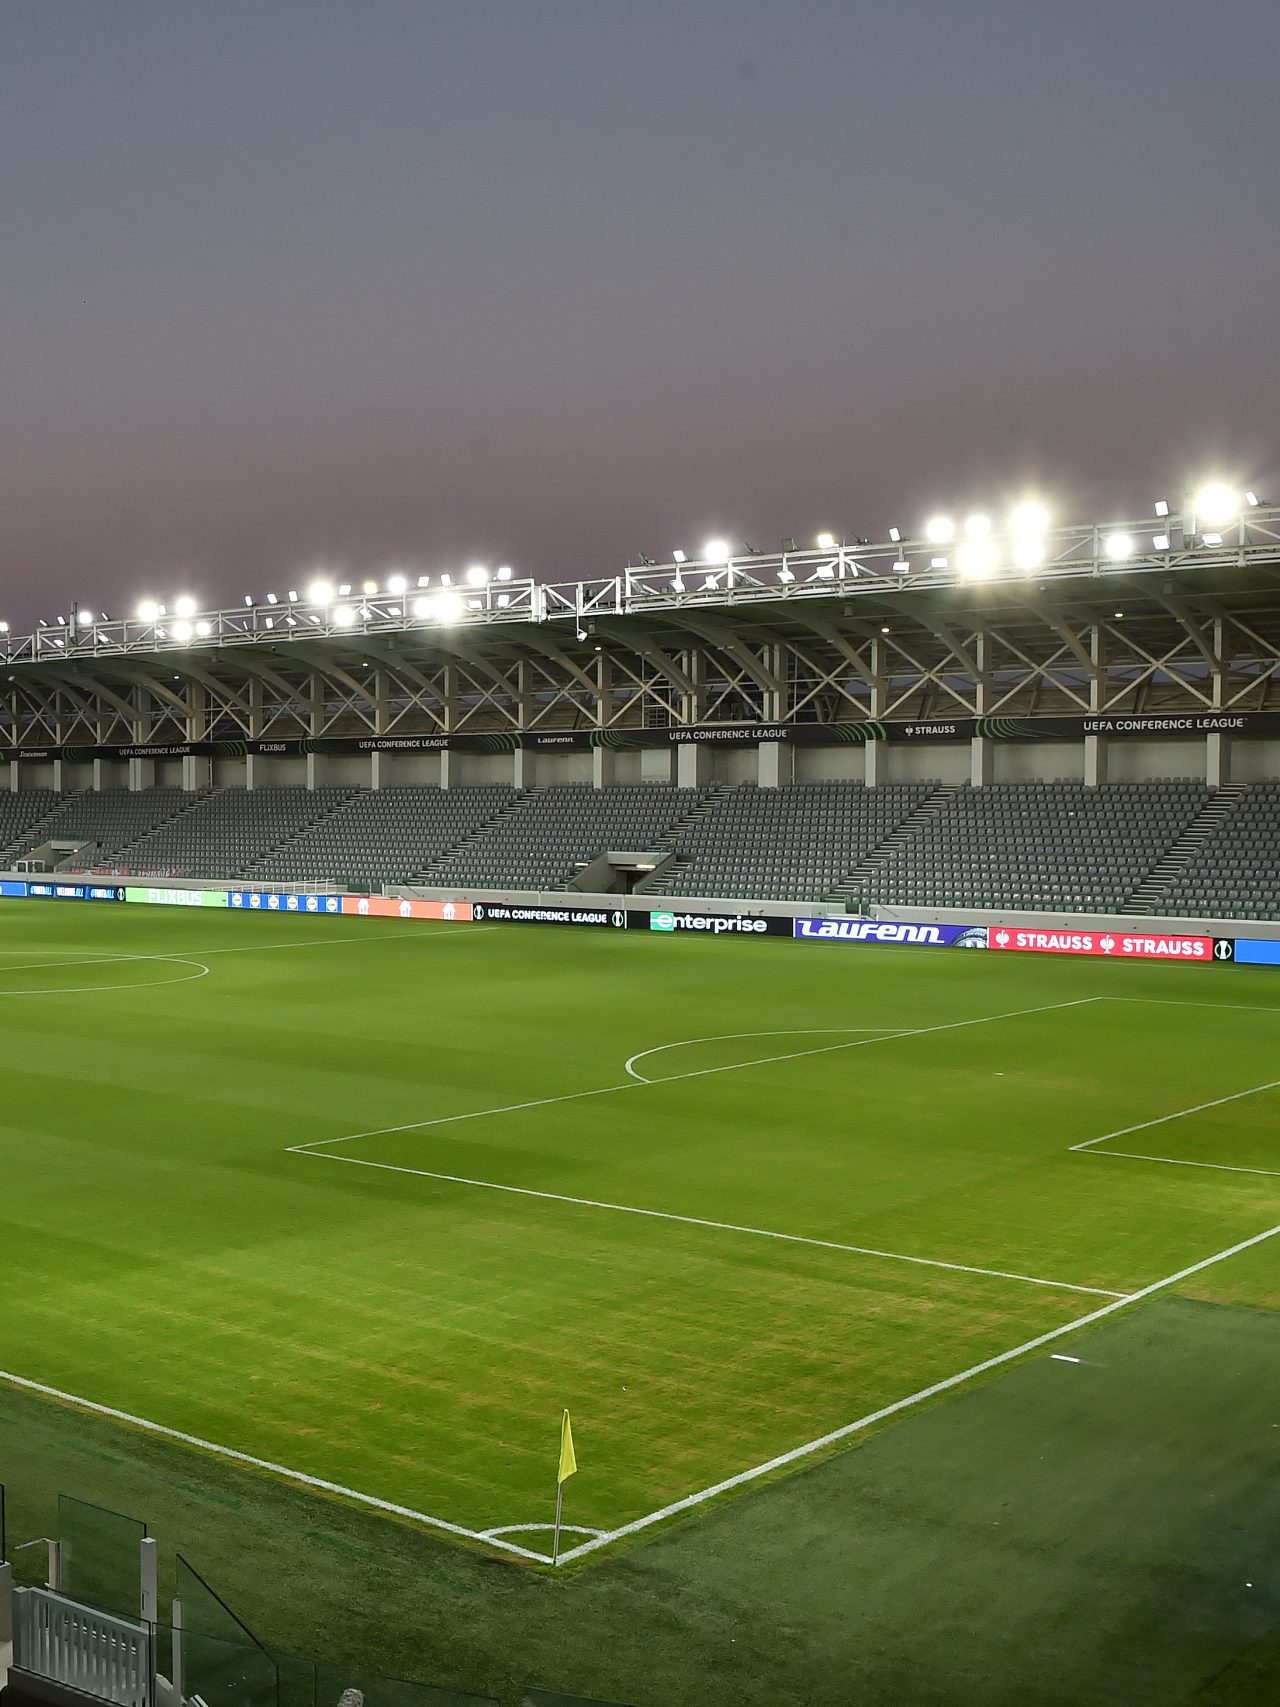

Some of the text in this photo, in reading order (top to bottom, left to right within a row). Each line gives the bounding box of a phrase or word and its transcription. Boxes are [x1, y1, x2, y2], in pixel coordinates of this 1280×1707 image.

[914, 725, 956, 735] STRAUSS
[1083, 718, 1244, 731] UEFA CONFERENCE LEAGUE
[669, 729, 787, 740] UEFA CONFERENCE LEAGUE
[358, 739, 449, 749] UEFA CONFERENCE LEAGUE
[487, 908, 607, 923] UEFA CONFERENCE LEAGUE
[657, 914, 767, 933] enterprise
[1016, 933, 1204, 956] STRAUSS STRAUSS
